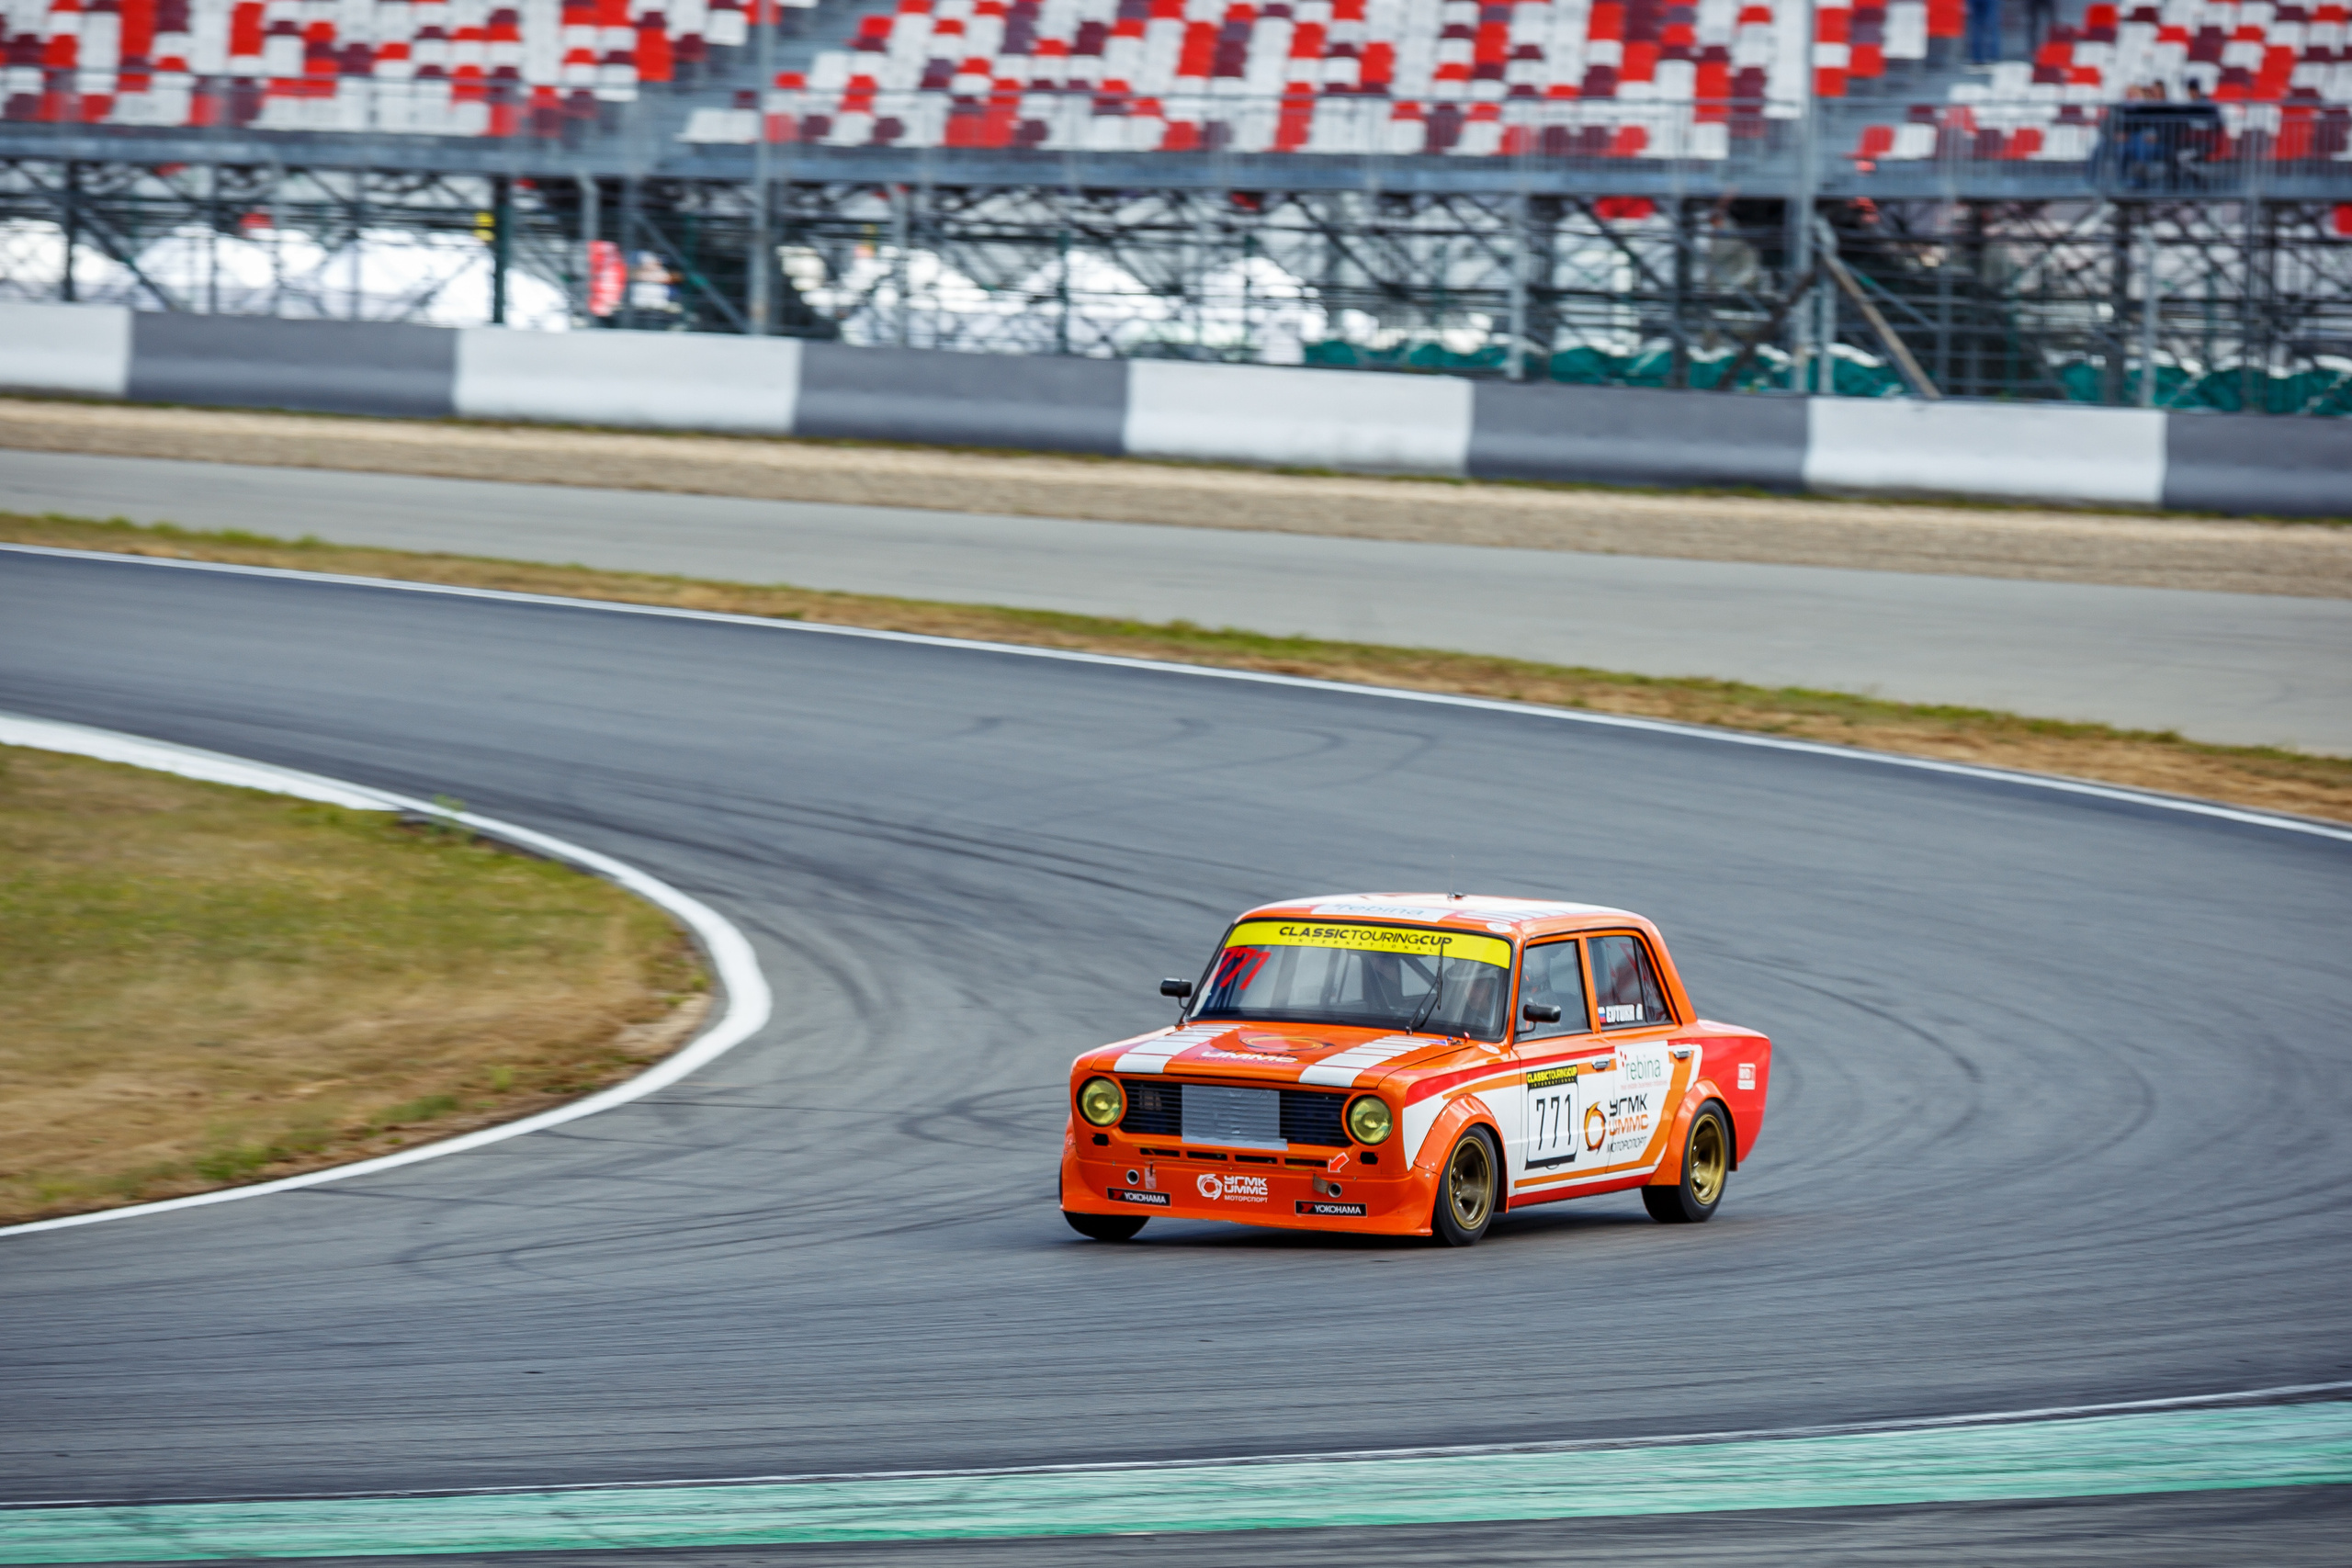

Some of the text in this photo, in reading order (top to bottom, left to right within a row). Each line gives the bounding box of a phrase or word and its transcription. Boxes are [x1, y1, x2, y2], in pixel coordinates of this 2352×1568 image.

[1279, 926, 1452, 945] CLASSICTOURINGCUP
[1288, 938, 1432, 953] INTERNATIONAL
[1625, 1055, 1661, 1081] rebina
[1609, 1093, 1647, 1117] УГМК
[1536, 1094, 1572, 1151] 771
[1224, 1176, 1268, 1187] УГМК
[1124, 1191, 1167, 1204] YOKOHAMA
[1224, 1195, 1268, 1203] МОТОРСПОРТ
[1314, 1204, 1362, 1214] YOKOHAMA
